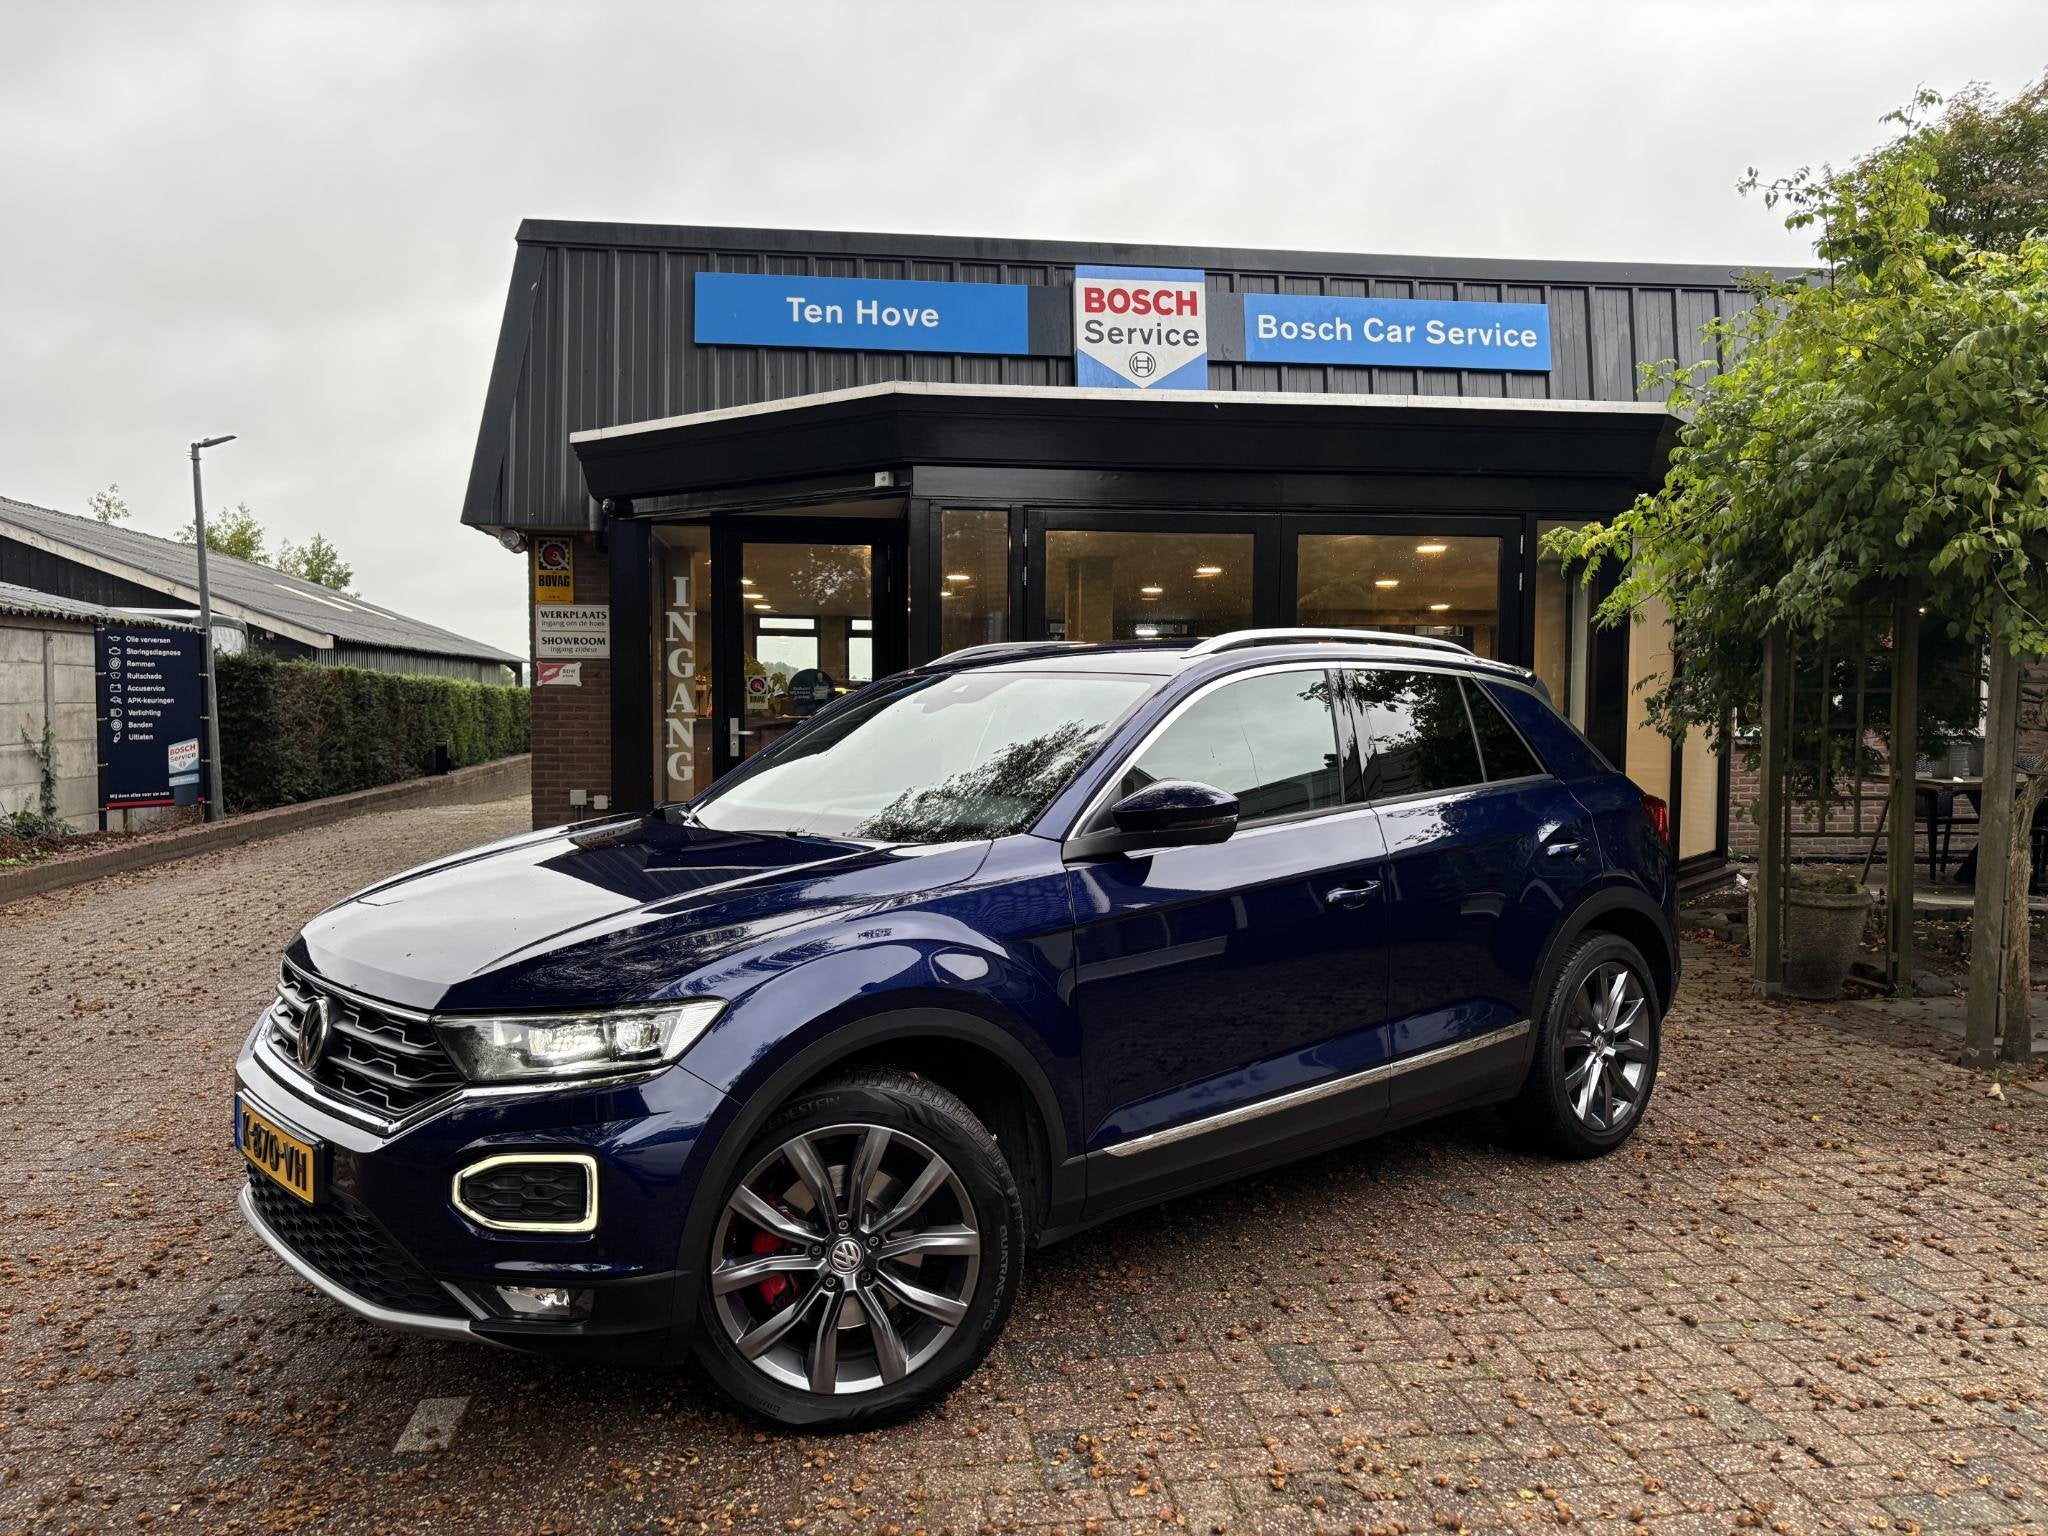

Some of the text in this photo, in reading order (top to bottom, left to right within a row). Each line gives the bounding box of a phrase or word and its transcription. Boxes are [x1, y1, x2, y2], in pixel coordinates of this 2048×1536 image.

[1084, 287, 1198, 317] BOSCH
[786, 297, 940, 328] Ten Hove
[1084, 319, 1200, 347] Service
[1257, 314, 1538, 348] Bosch Car Service
[538, 574, 570, 588] BOVAG
[540, 610, 607, 619] WERKPLAATS
[541, 620, 565, 628] Ingang
[125, 635, 139, 643] Olie
[541, 636, 606, 646] SHOWROOM
[126, 647, 182, 656] Storingsdiagnose
[126, 672, 163, 680] Ruitschade
[665, 576, 698, 781] INGANG
[127, 684, 166, 692] Accuservice
[128, 709, 162, 717] Verlichting
[128, 733, 154, 741] Uitlaten
[170, 743, 196, 755] BOSCH
[169, 752, 197, 762] Service
